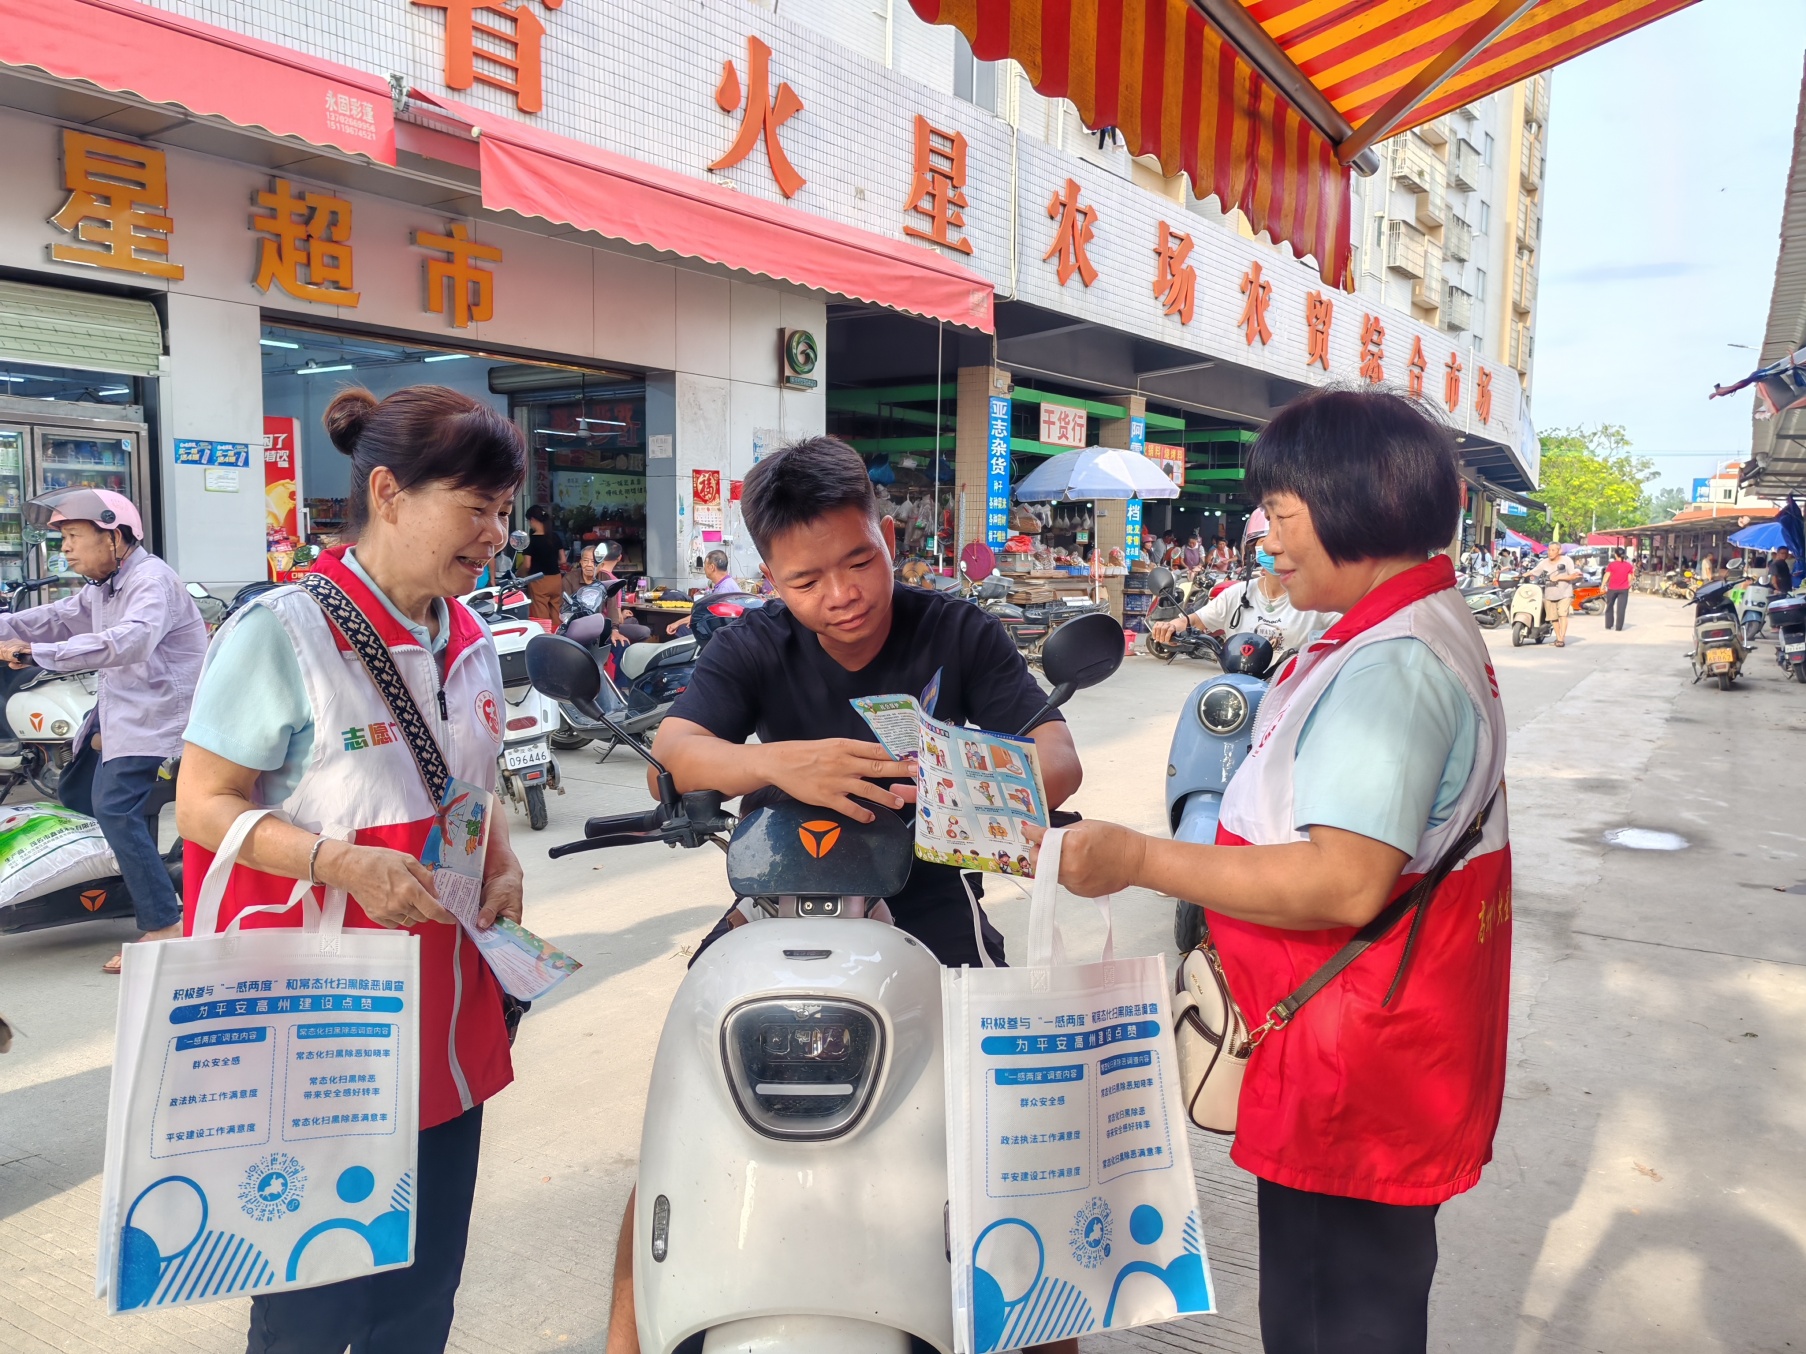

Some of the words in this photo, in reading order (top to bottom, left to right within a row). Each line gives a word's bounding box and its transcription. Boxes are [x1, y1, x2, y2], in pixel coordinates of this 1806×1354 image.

[46, 128, 502, 328] 星超市
[1042, 405, 1085, 443] 干货行
[990, 400, 1009, 475] 亚志杂货
[699, 472, 714, 499] 福
[510, 751, 547, 767] 096446
[197, 997, 372, 1018] 为平安高州建设点赞
[299, 1026, 389, 1036] 常态化扫黑除恶调查内容
[1016, 1025, 1137, 1052] 为平安高州建设点赞
[192, 1056, 240, 1069] 群众安全感
[296, 1049, 390, 1060] 常态化扫黑除恶知晓率
[309, 1074, 376, 1086] 常态化扫黑除恶
[169, 1088, 258, 1107] 政法执法工作满意度
[303, 1088, 380, 1099] 带来安全感好转率
[1020, 1095, 1065, 1107] 群众安全感
[292, 1113, 388, 1127] 常态化扫黑除恶满意率
[166, 1123, 256, 1142] 平安建设工作满意度
[1000, 1130, 1080, 1145] 政法执法工作满意度
[1001, 1166, 1080, 1182] 平安建设工作满意度
